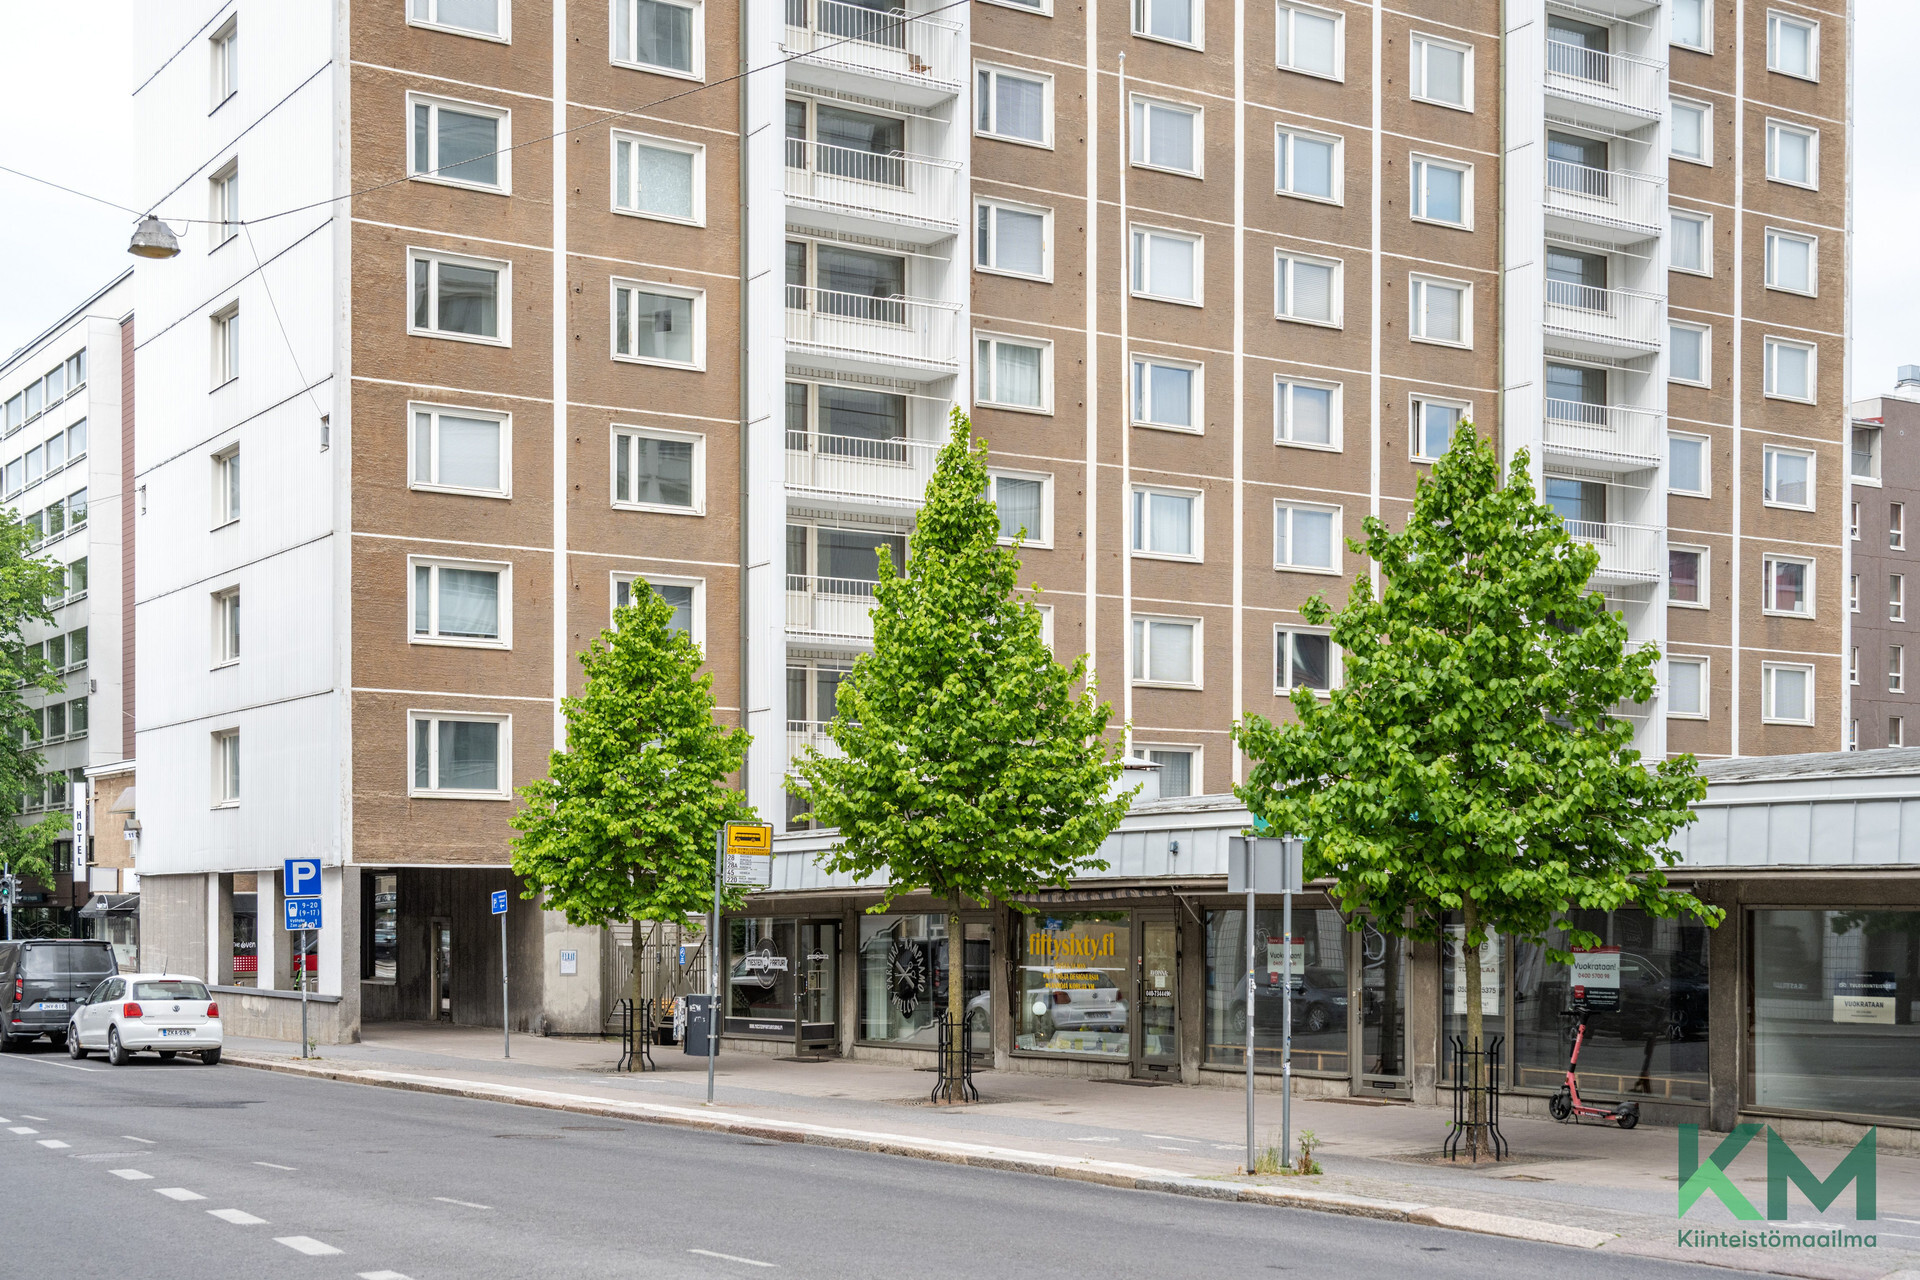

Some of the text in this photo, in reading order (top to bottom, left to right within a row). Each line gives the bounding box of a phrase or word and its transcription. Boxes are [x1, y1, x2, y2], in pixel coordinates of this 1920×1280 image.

[292, 861, 316, 893] P
[1029, 932, 1116, 961] fiftysixty.fi
[1574, 962, 1617, 971] Vuokrataan!
[1844, 1000, 1884, 1008] VUOKRATAAN
